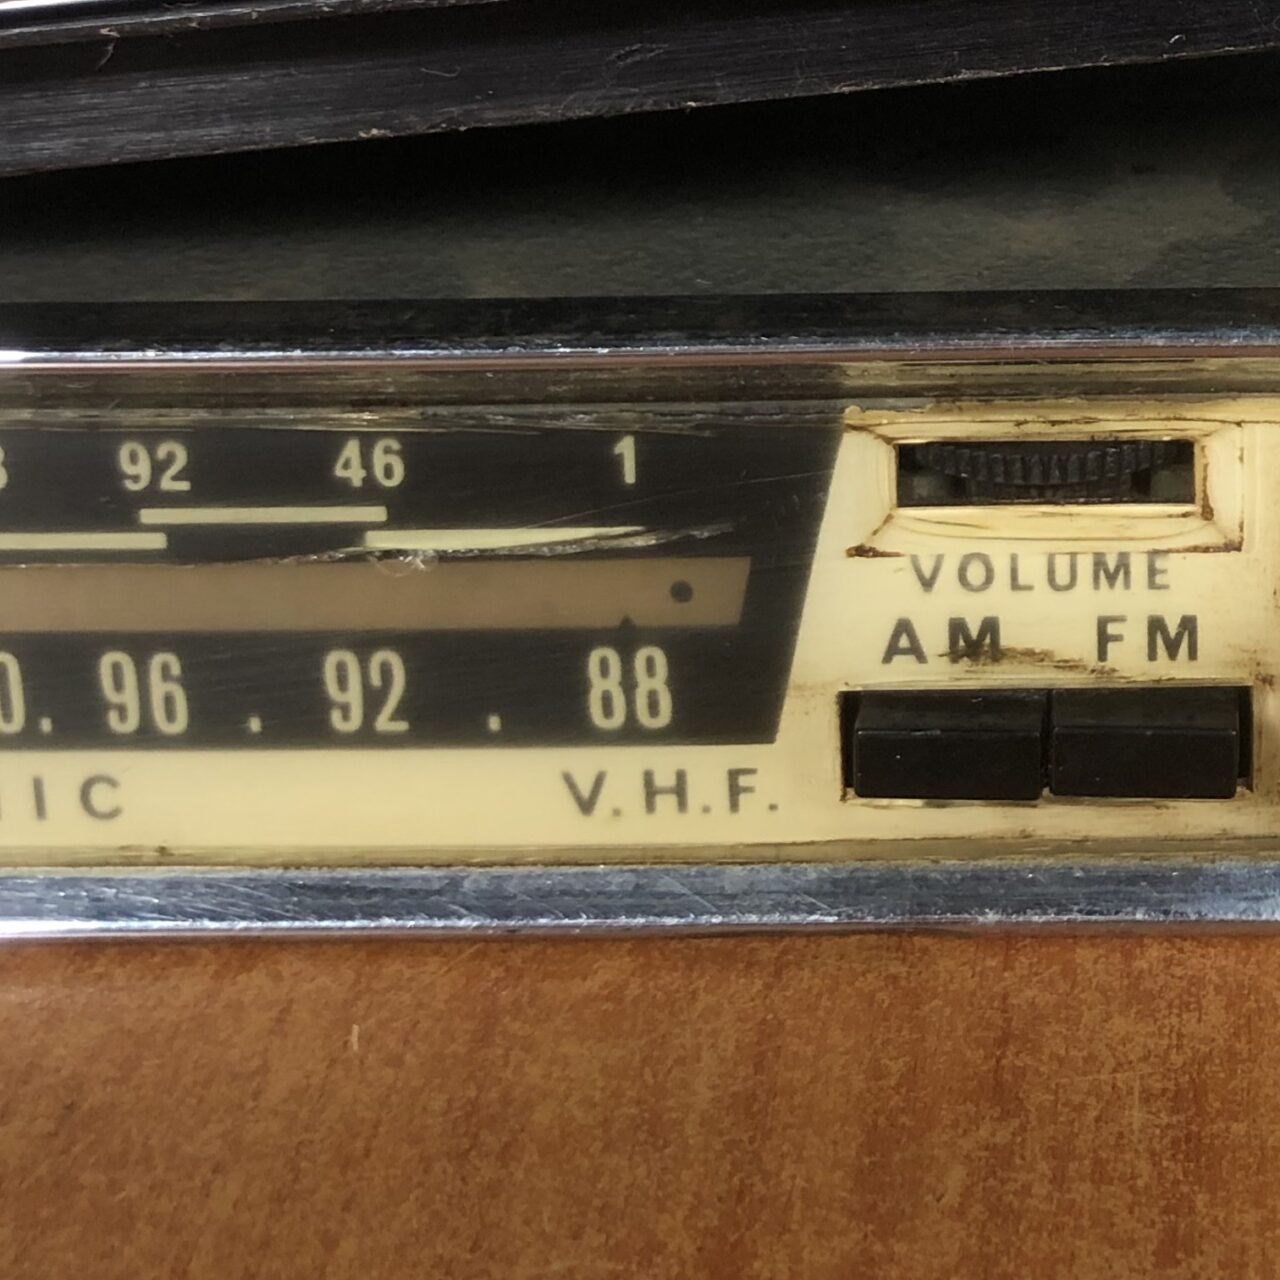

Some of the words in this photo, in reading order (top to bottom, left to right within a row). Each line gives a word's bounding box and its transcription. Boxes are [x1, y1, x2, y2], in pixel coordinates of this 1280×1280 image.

[118, 440, 192, 492] 92
[333, 438, 406, 489] 46
[613, 435, 638, 485] 1
[909, 552, 1172, 592] VOLUME
[881, 615, 1003, 664] AM
[1096, 614, 1199, 663] FM
[99, 650, 189, 735] 96
[322, 649, 410, 734] 92
[586, 645, 674, 730] 88
[0, 773, 123, 821] IC
[561, 768, 780, 819] V.H.F.
